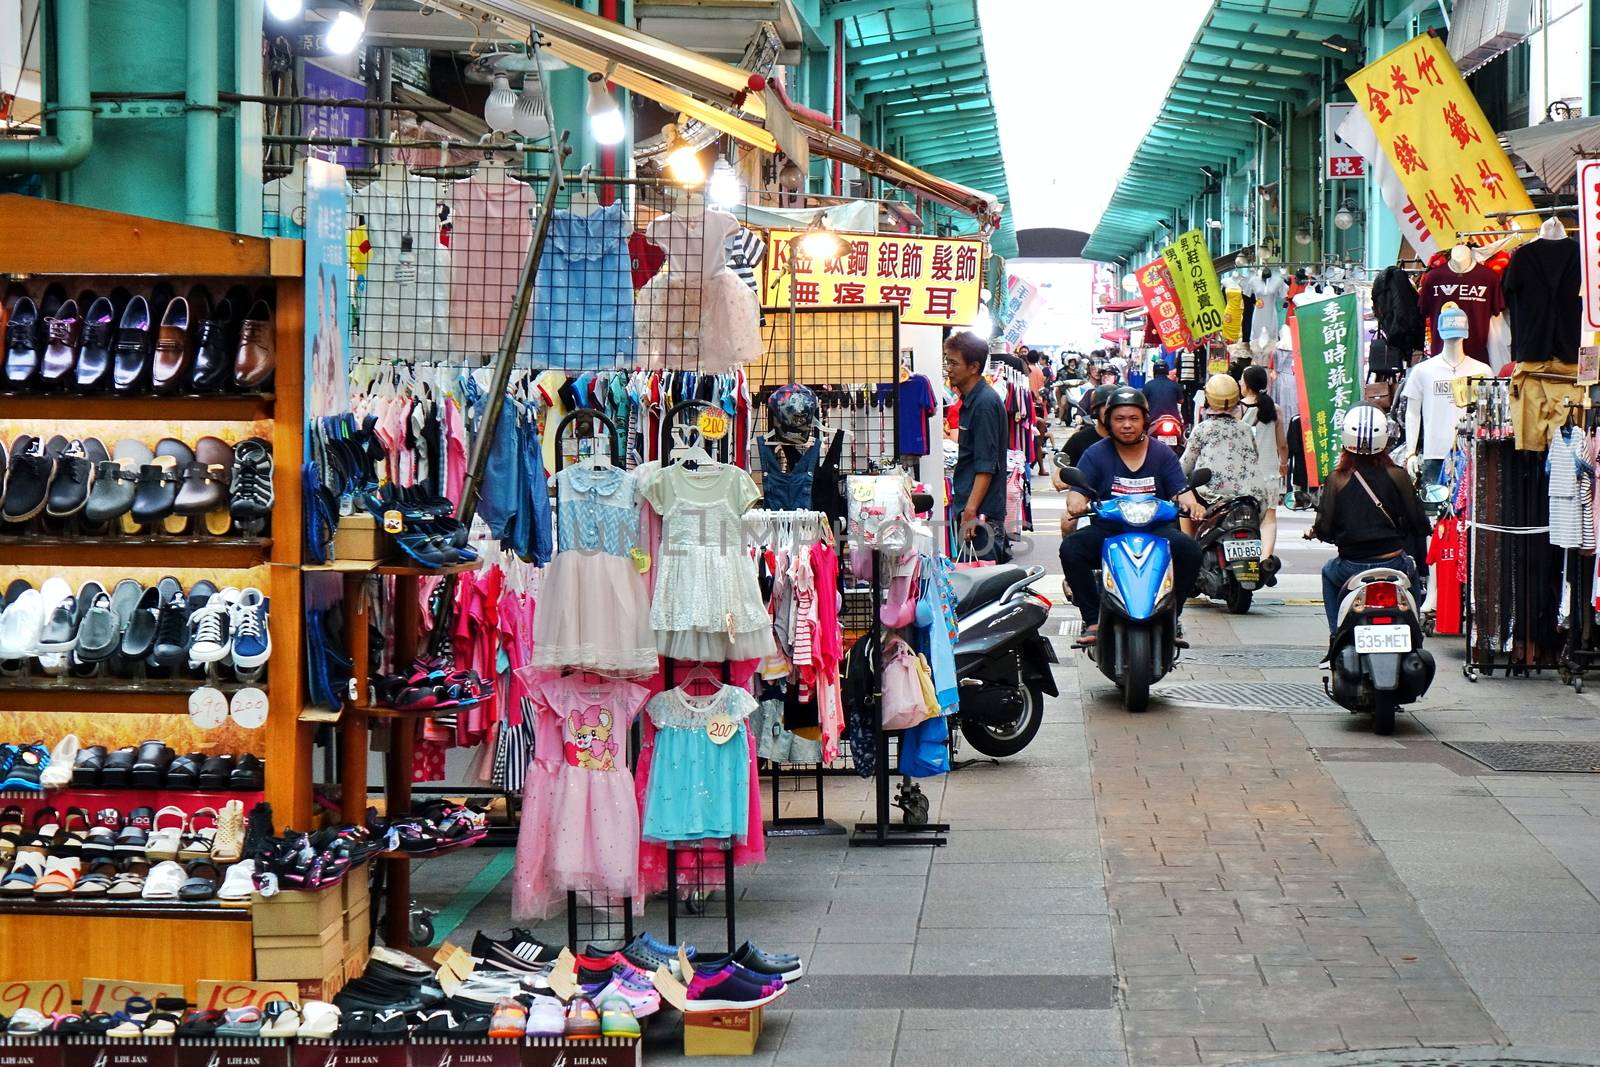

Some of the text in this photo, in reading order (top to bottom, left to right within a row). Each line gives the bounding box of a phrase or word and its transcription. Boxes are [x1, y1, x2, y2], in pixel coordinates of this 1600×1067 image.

[1335, 157, 1365, 176] 批
[876, 241, 923, 281] 銀飾
[931, 244, 978, 283] 髮飾
[1459, 284, 1488, 297] EA7
[702, 417, 725, 434] 200
[1357, 633, 1409, 649] 535-MET
[709, 722, 733, 738] 200
[17, 1056, 35, 1065] JAN
[131, 1055, 148, 1064] JAN
[244, 1056, 261, 1066] JAN
[361, 1055, 379, 1064] JAN
[476, 1054, 493, 1063] JAN
[590, 1056, 608, 1066] JAN
